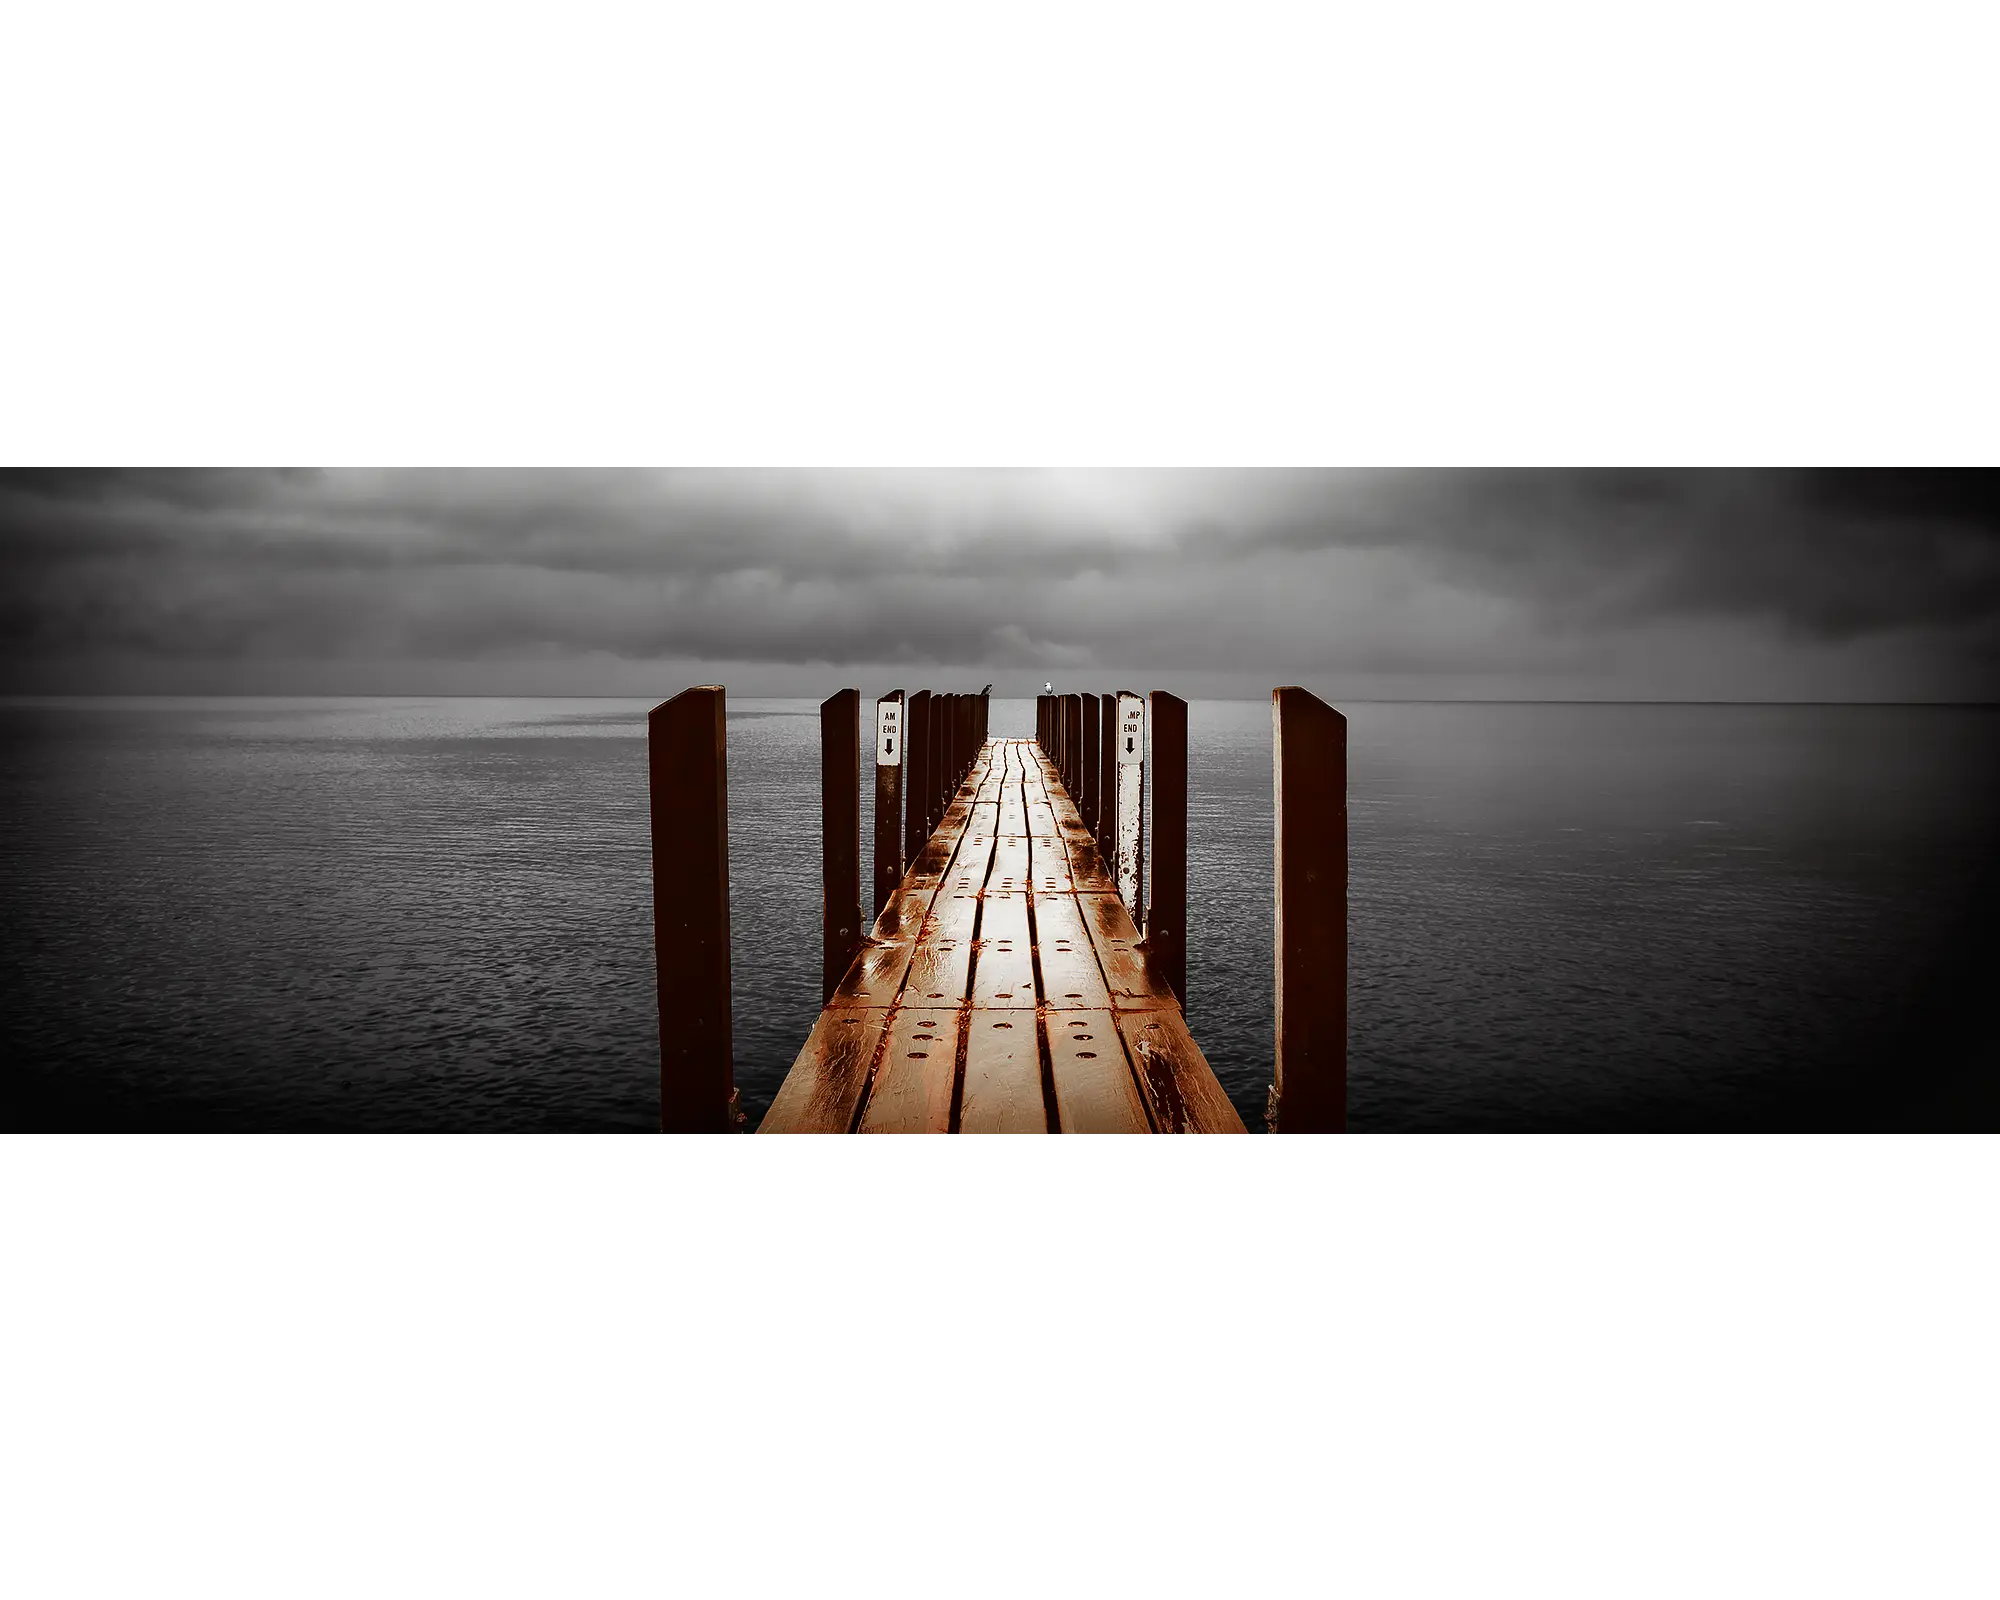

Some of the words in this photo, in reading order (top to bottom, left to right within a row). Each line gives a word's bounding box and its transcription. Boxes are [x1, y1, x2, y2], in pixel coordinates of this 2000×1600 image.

[884, 712, 896, 720] AM
[882, 725, 897, 734] END
[1123, 723, 1138, 733] END
